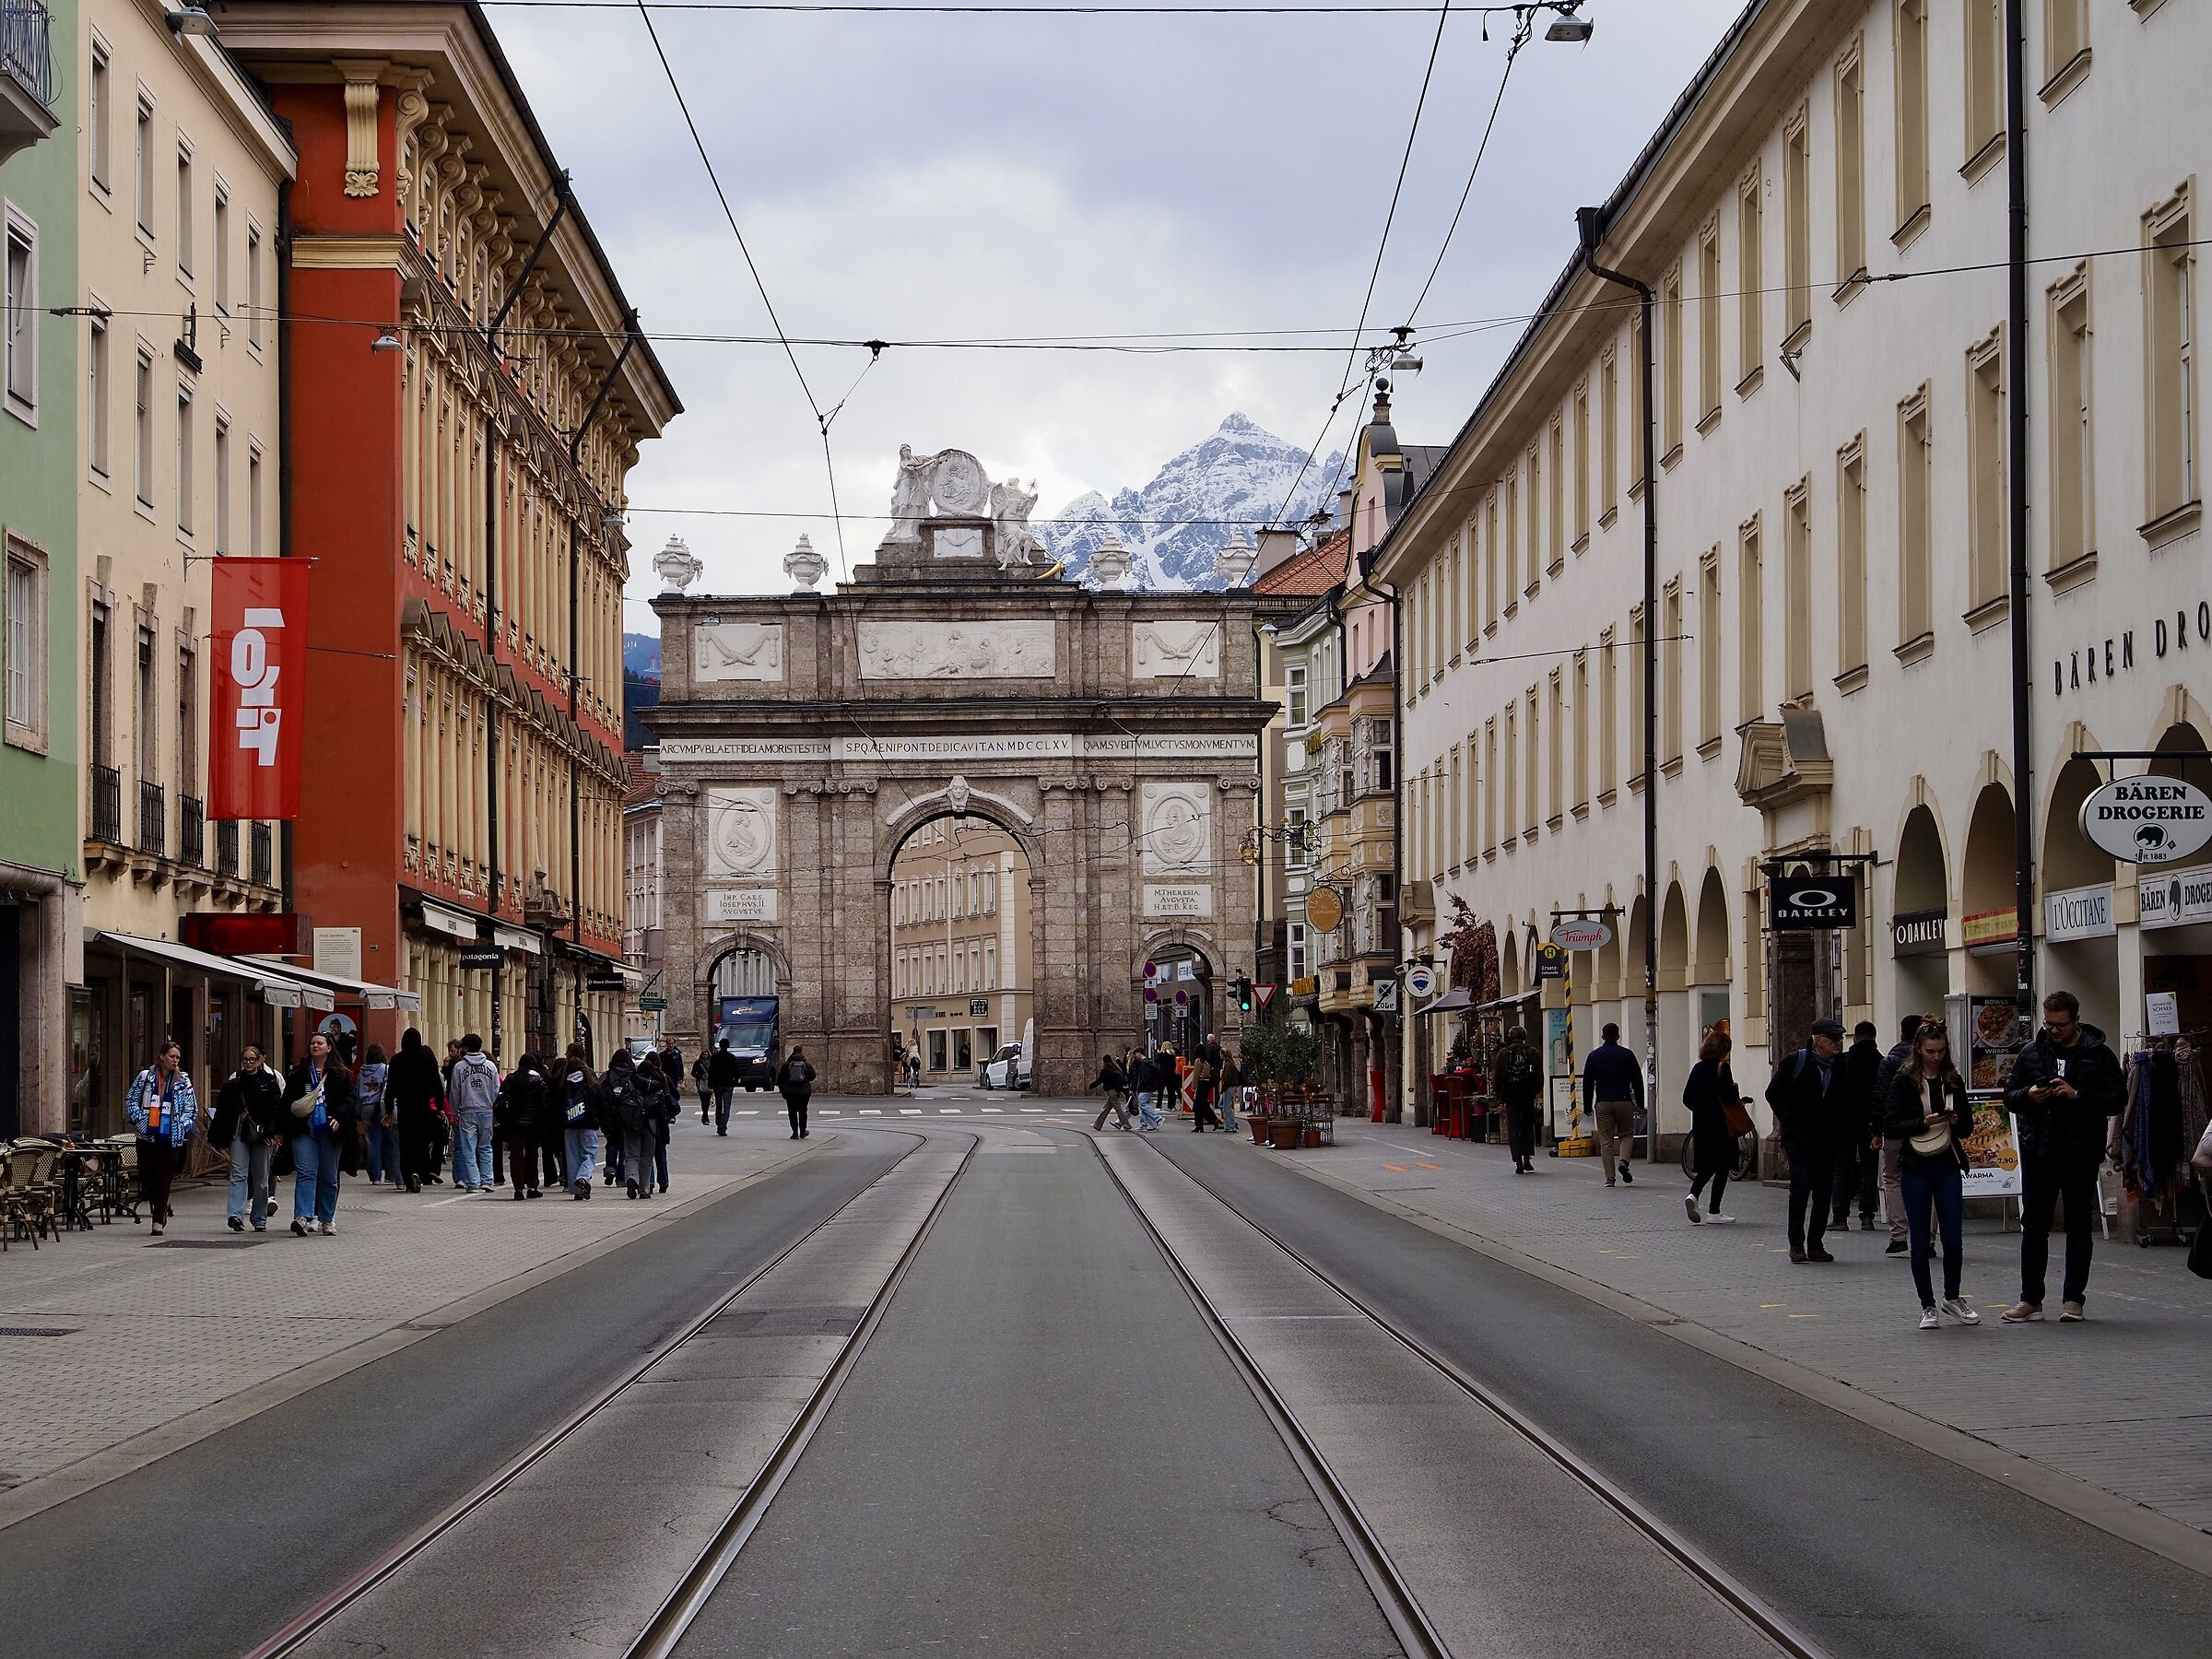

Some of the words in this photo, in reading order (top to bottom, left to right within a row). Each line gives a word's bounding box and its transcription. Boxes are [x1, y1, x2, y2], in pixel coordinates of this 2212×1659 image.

[2054, 630, 2133, 695] BÄREN
[2115, 782, 2187, 800] BÄREN
[2098, 806, 2205, 820] DROGERIE
[2141, 886, 2166, 912] BÄREN
[2184, 882, 2212, 906] DROGE
[1778, 908, 1848, 918] OAKLEY
[1557, 927, 1604, 947] Triumph
[1907, 918, 1944, 944] OAKLEY
[462, 952, 500, 961] patagonia
[567, 1101, 586, 1121] NIKE
